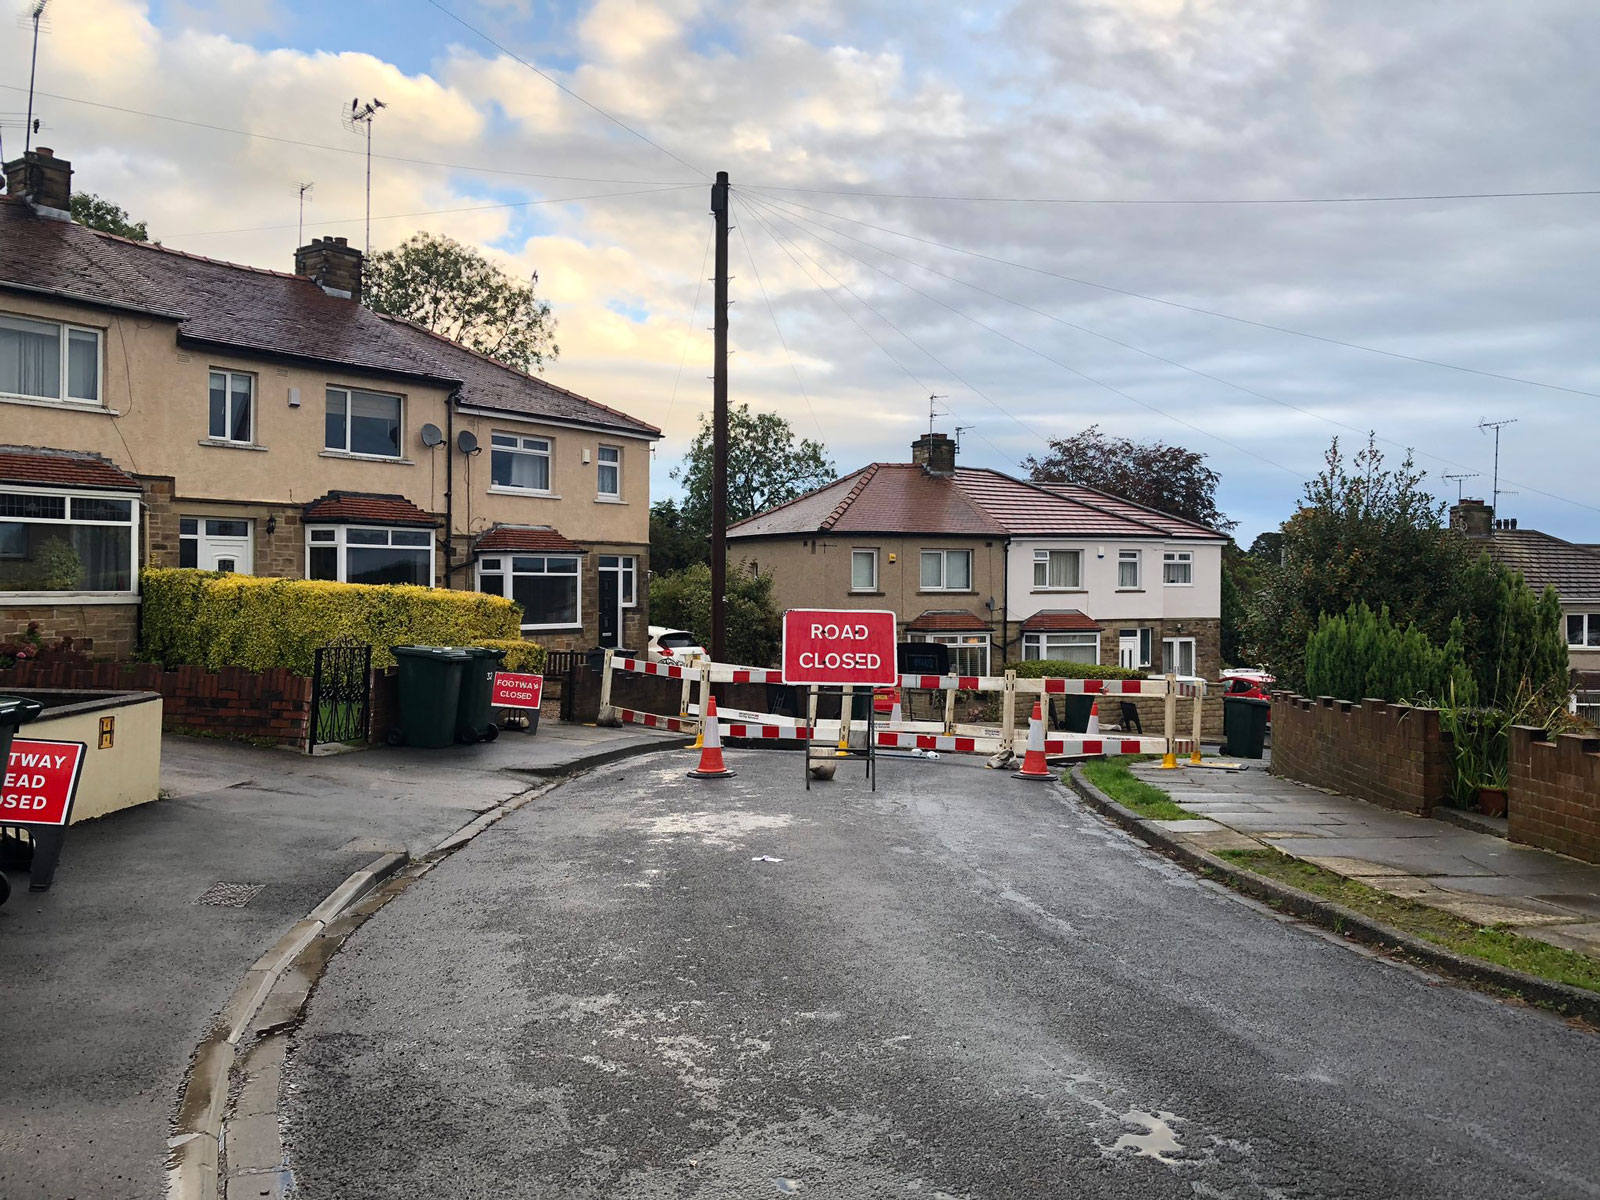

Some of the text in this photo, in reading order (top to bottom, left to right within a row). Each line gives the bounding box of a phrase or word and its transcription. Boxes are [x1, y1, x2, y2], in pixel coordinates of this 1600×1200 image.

[811, 624, 869, 640] ROAD
[799, 652, 881, 669] CLOSED
[497, 679, 539, 689] FOOTWAY
[500, 690, 532, 700] CLOSED
[9, 752, 67, 769] TWAY
[3, 773, 46, 789] EAD
[0, 794, 47, 810] SED
